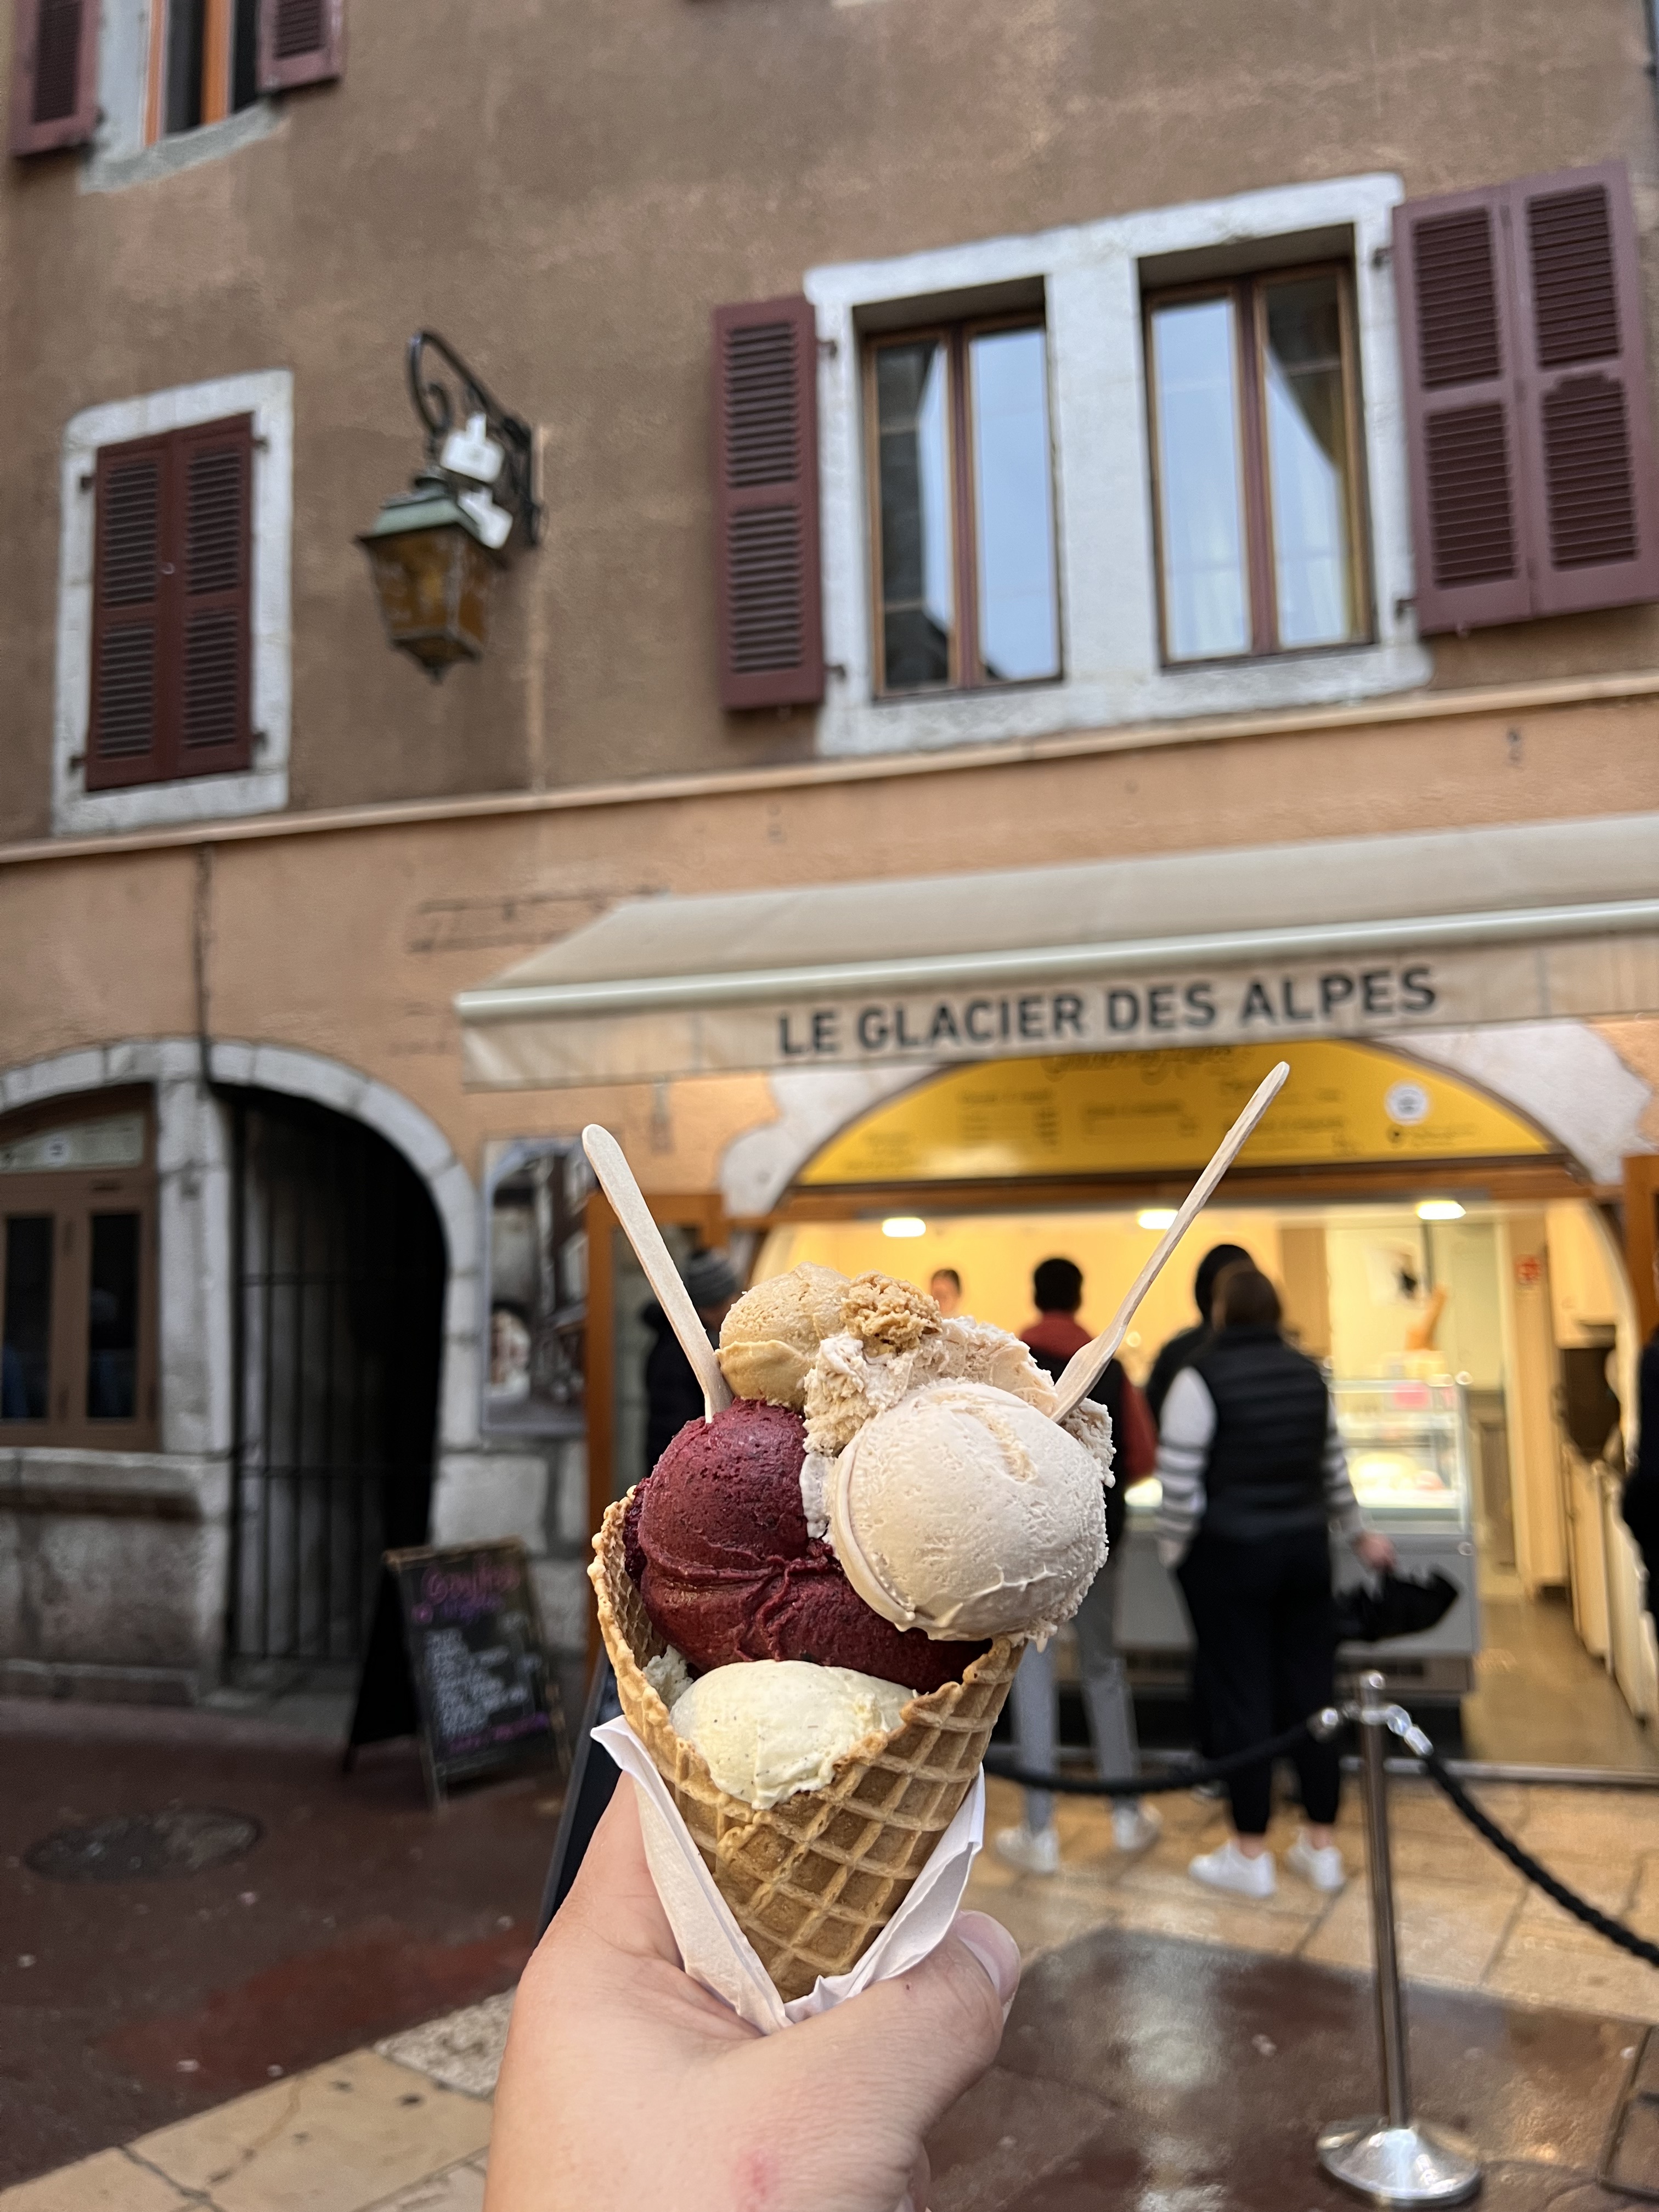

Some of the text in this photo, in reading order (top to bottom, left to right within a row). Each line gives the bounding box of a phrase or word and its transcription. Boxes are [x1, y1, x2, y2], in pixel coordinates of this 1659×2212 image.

[777, 964, 1437, 1056] LE GLACIER DES ALPES
